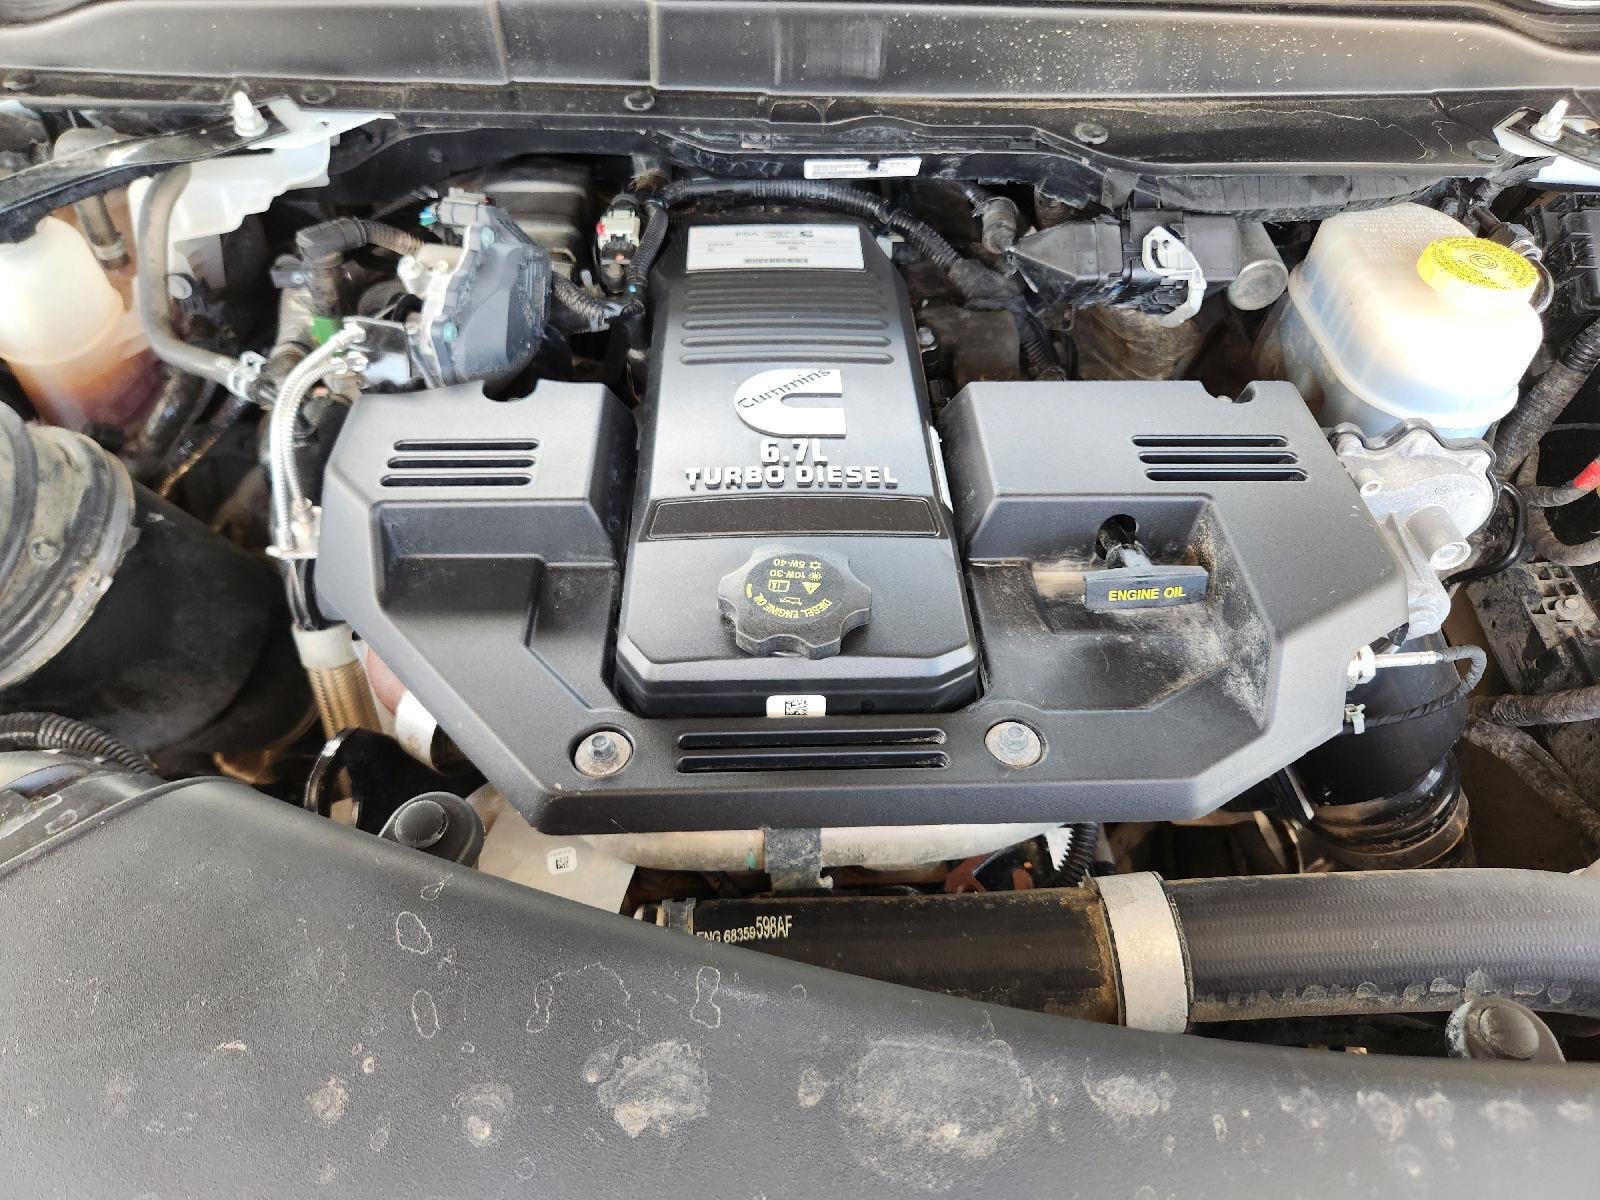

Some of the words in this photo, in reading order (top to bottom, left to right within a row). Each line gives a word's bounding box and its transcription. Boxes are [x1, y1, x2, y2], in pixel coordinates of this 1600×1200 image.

[737, 369, 830, 408] Cummins
[760, 438, 829, 466] 6.7L
[685, 465, 785, 489] TURBO
[774, 559, 805, 568] 5W-40
[770, 569, 805, 578] 10W-30
[1108, 588, 1159, 601] ENGINE
[1164, 586, 1186, 598] OIL
